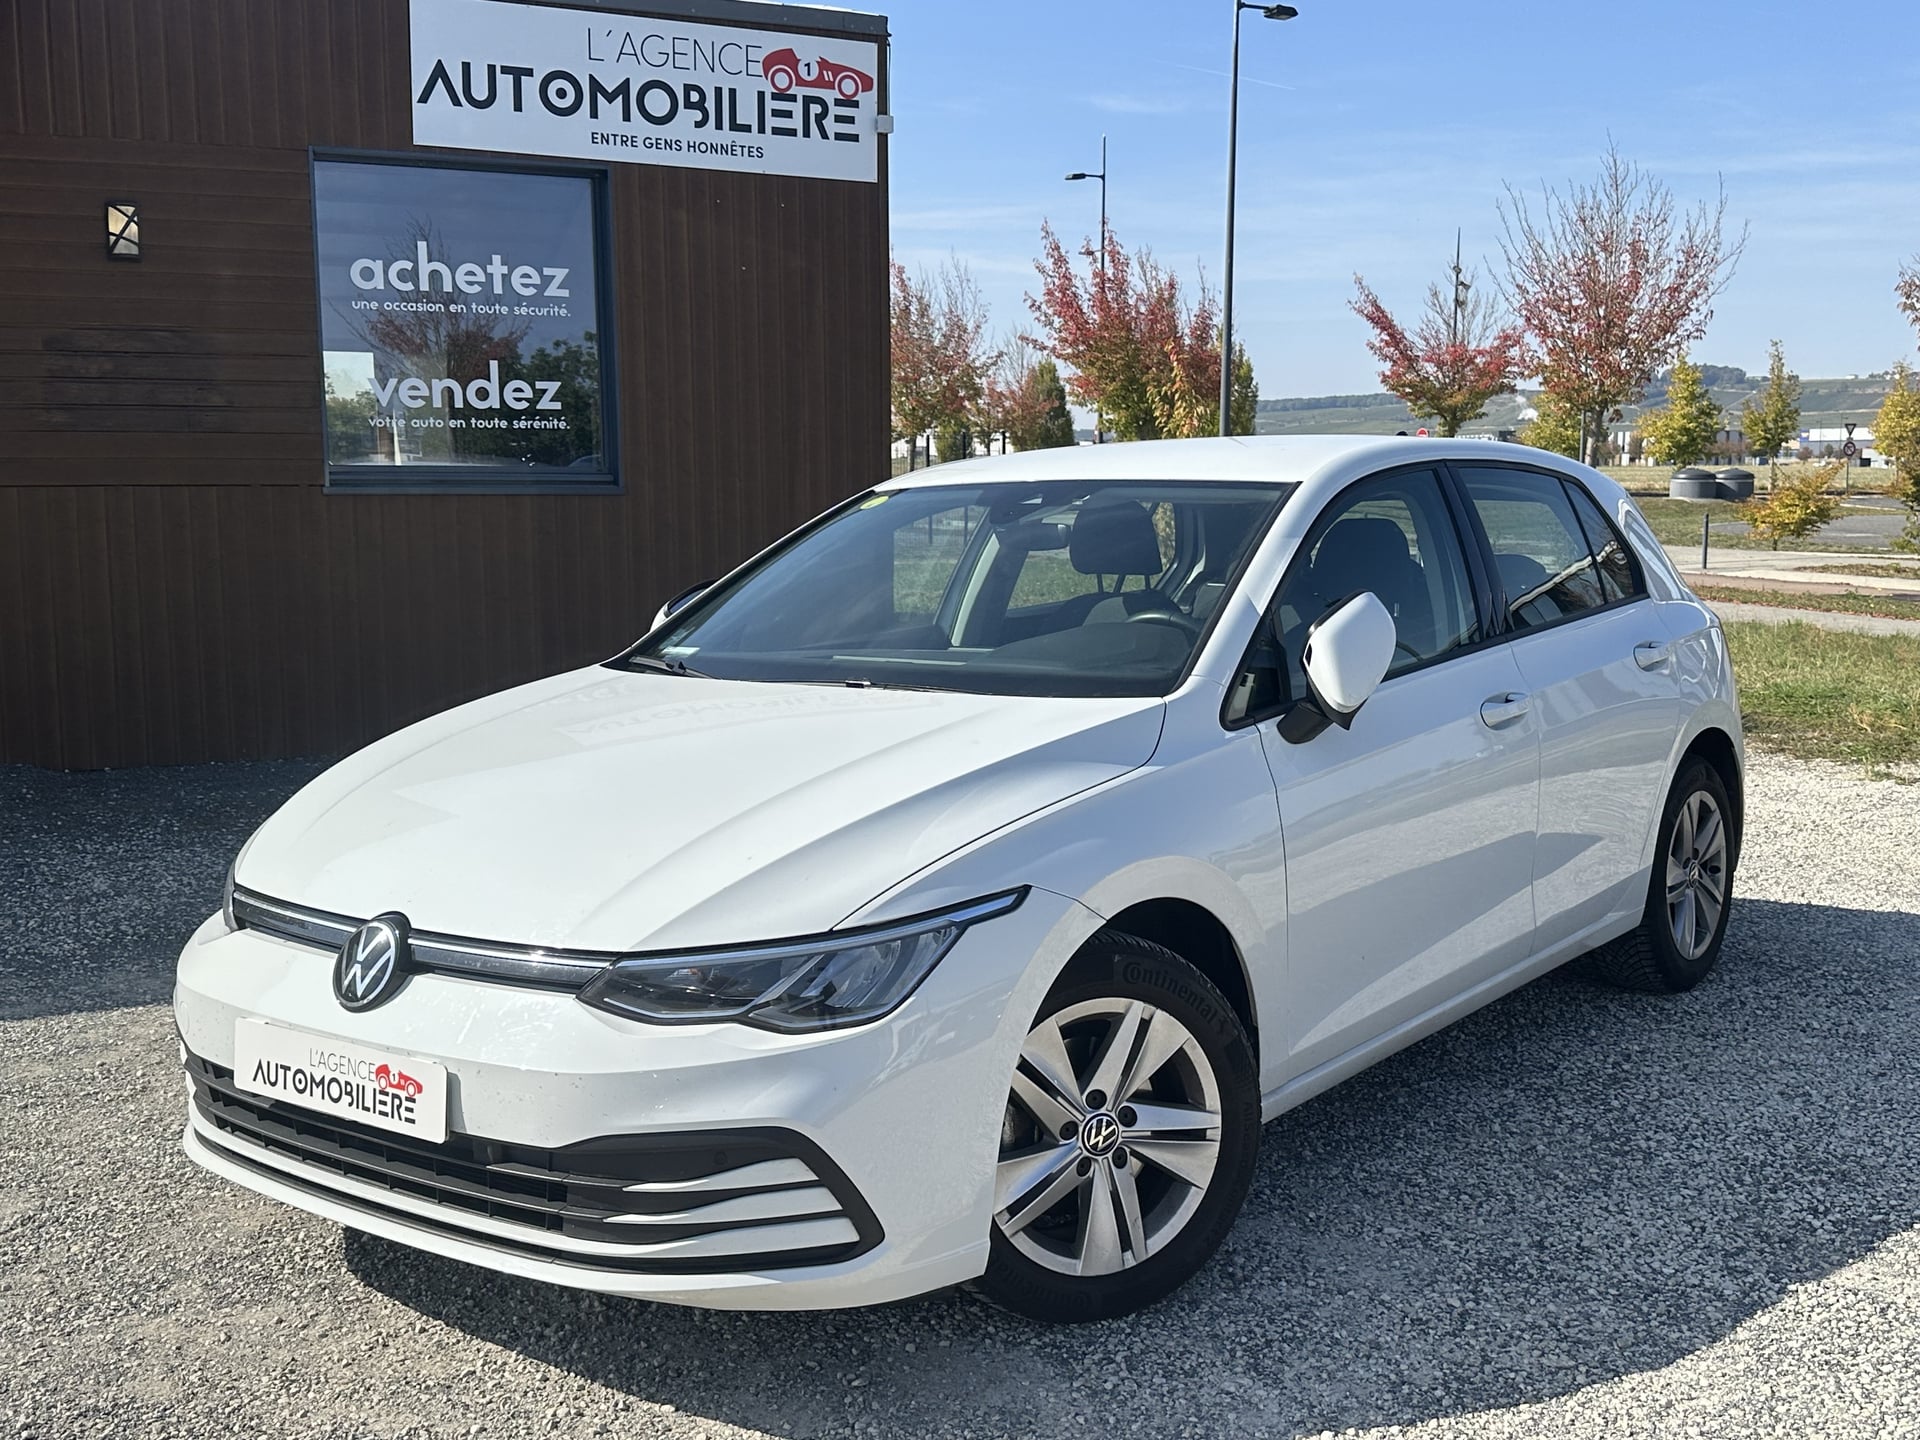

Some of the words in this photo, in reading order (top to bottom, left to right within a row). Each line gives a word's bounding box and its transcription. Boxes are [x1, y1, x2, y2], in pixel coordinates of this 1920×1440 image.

[587, 26, 763, 78] L'AGENCE
[590, 131, 638, 149] ENTRE
[642, 134, 683, 153] GENS
[687, 138, 765, 159] HONNÊTES
[350, 240, 570, 298] achetez
[351, 300, 379, 311] une
[383, 299, 445, 313] occasion
[449, 304, 467, 314] en
[470, 302, 509, 315] toute
[513, 302, 572, 318] sécurité.
[367, 359, 562, 411] vendez
[368, 417, 406, 429] votre
[411, 416, 444, 429] auto
[449, 418, 466, 429] en
[470, 416, 508, 430] toute
[512, 415, 571, 431] sérénité.
[1122, 960, 1218, 1025] Continental
[309, 1048, 376, 1083] L'AGENCE
